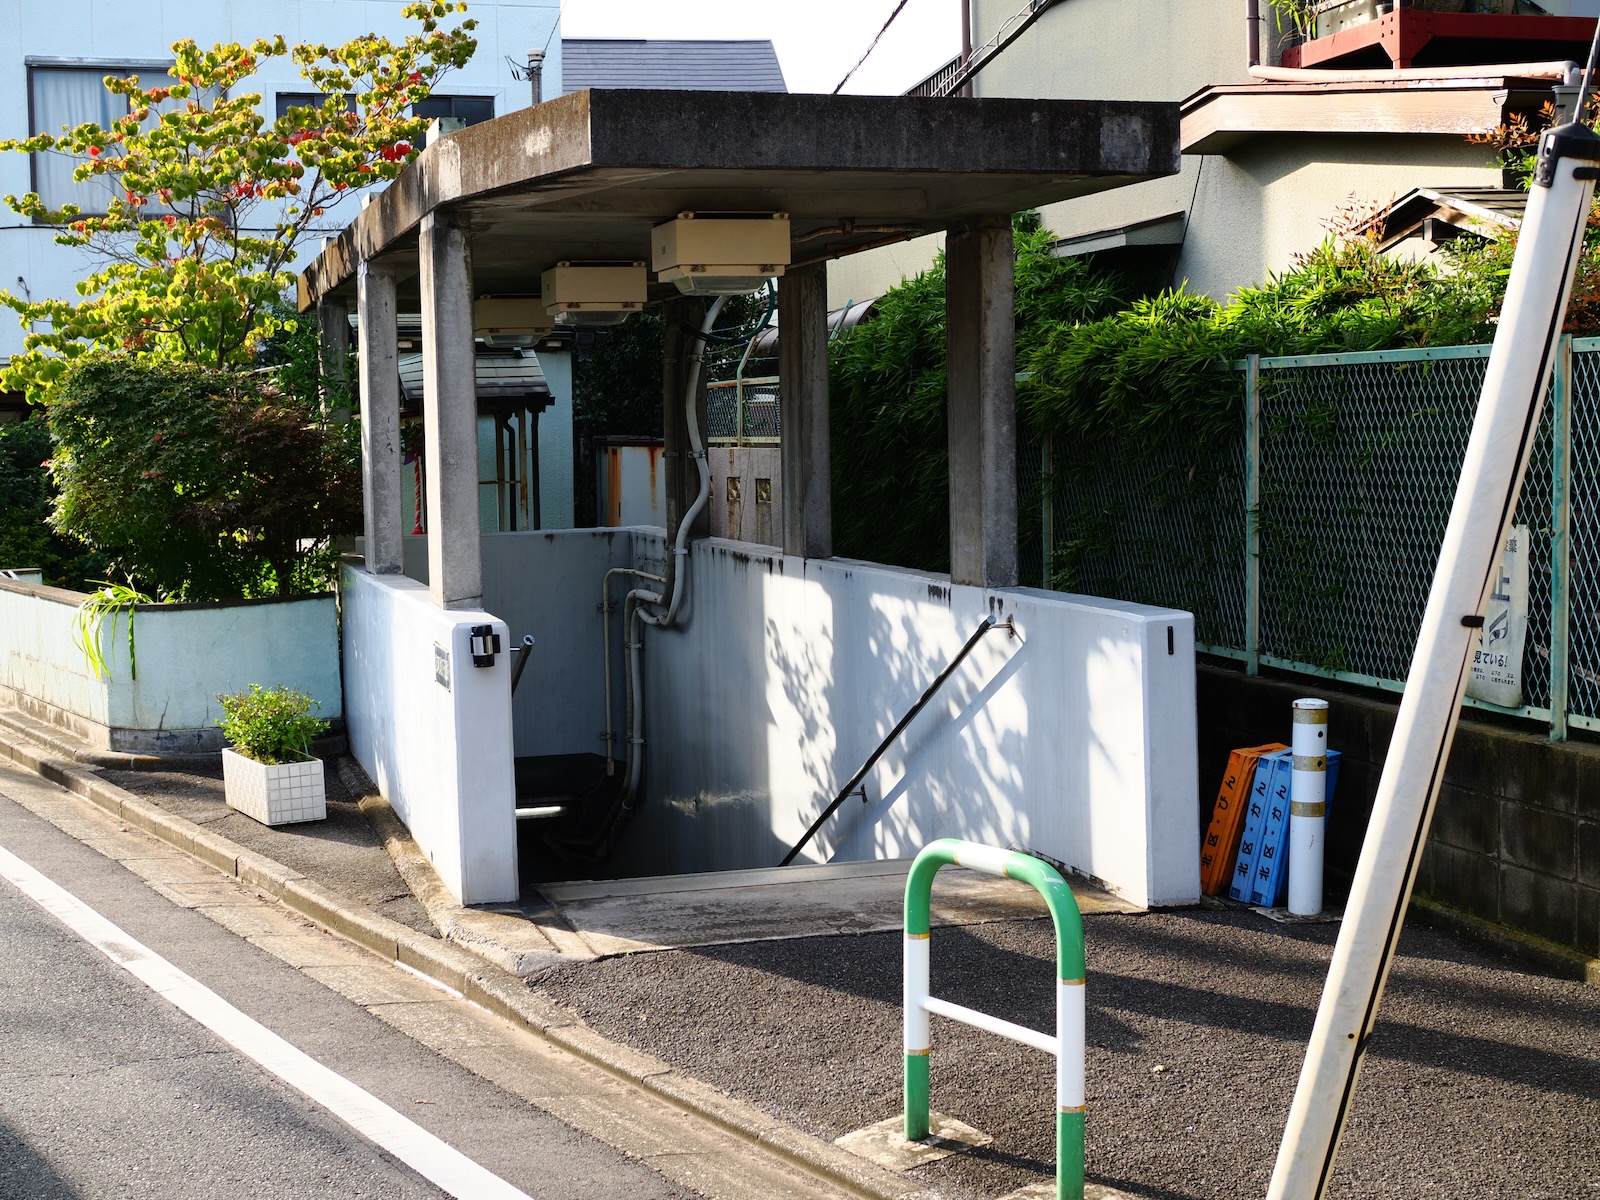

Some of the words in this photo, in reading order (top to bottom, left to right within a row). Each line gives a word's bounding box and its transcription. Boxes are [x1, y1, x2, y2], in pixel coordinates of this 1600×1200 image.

[1237, 781, 1266, 878] 北区・かん
[1258, 784, 1287, 881] 北区・かん
